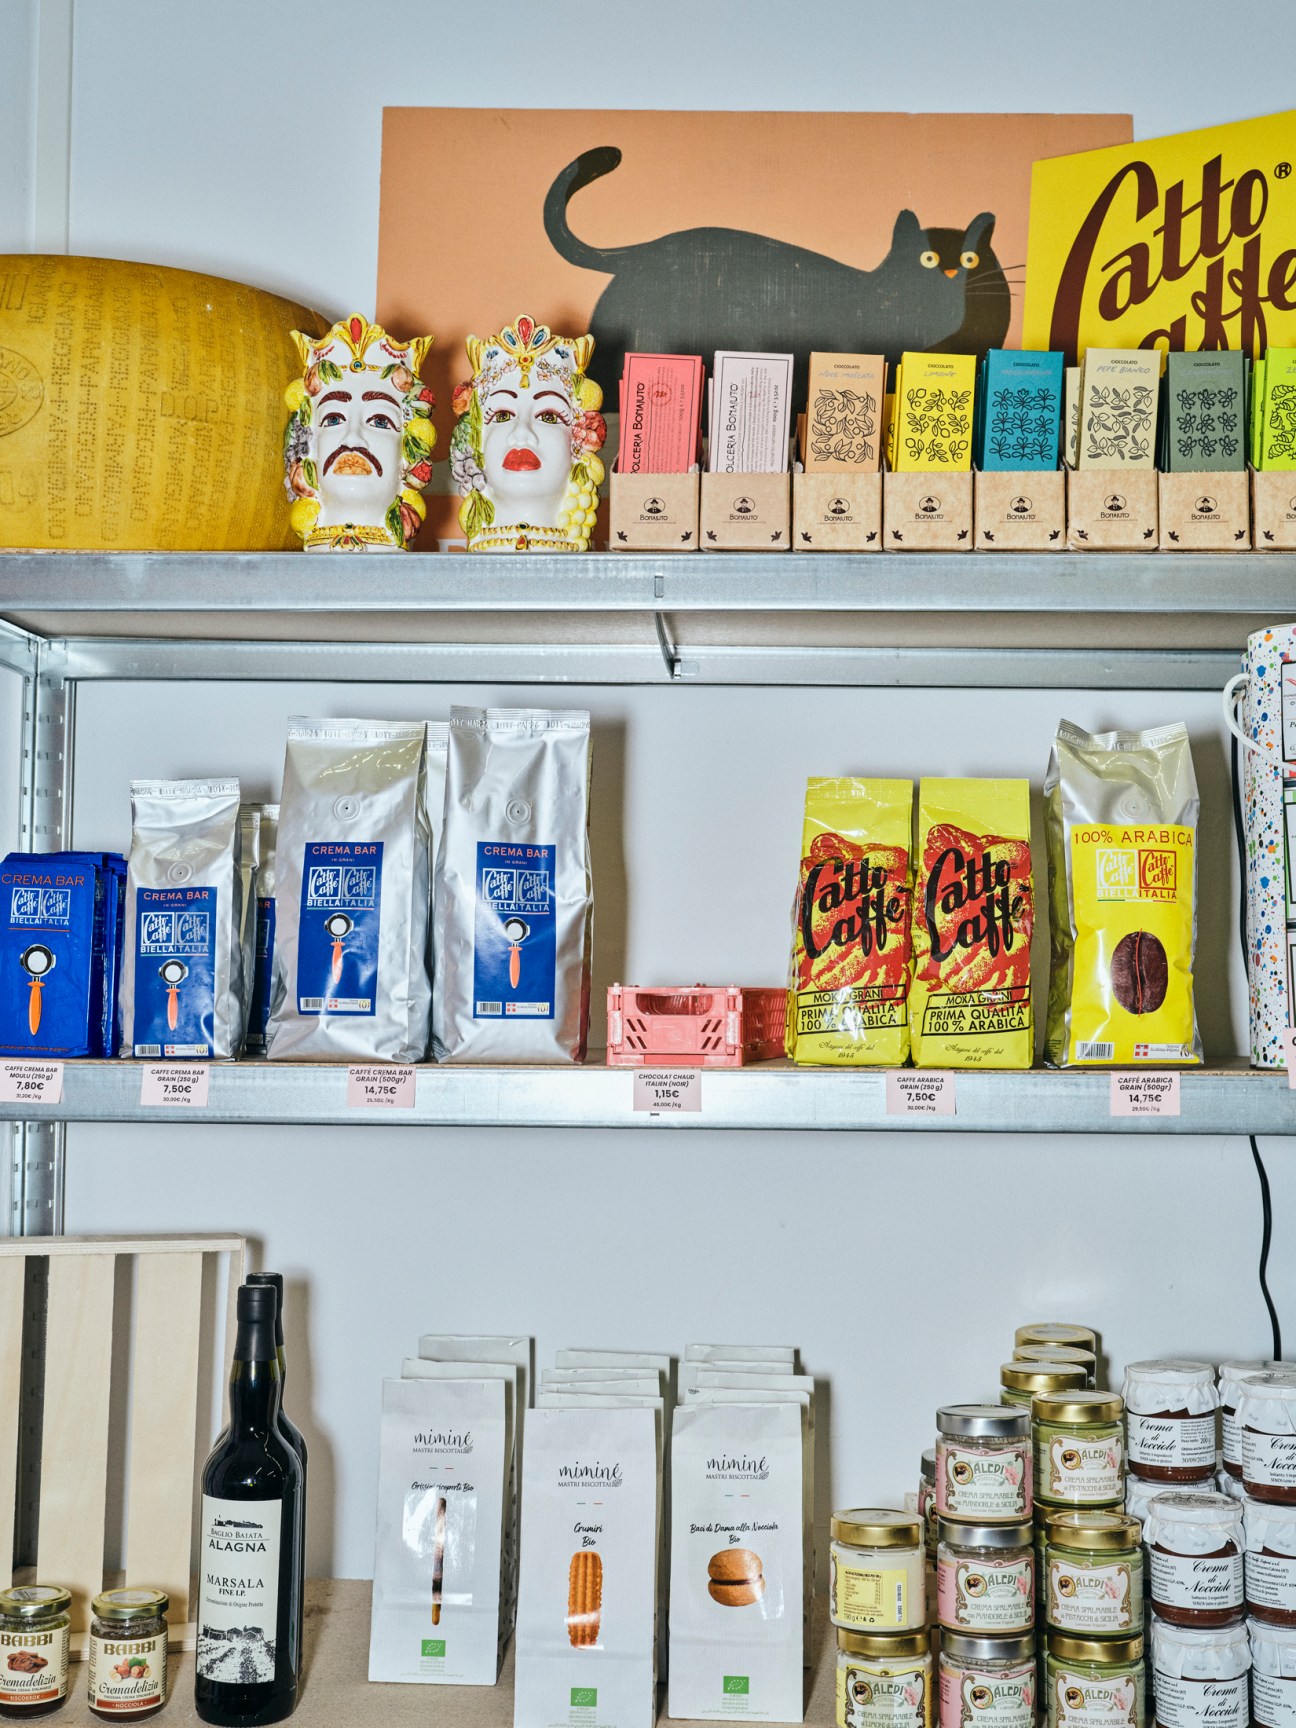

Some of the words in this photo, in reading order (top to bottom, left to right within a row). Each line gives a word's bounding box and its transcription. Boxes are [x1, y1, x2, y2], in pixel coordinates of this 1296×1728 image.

[1097, 365, 1116, 373] PEPE
[1075, 830, 1113, 844] 100%
[1121, 831, 1192, 846] ARABICA
[312, 846, 351, 855] CREMA
[355, 846, 376, 854] BAR
[484, 847, 523, 856] CREMA
[526, 849, 548, 858] BAR
[2, 873, 52, 886] CREMA
[56, 875, 84, 886] BAR
[143, 891, 182, 900] CREMA
[186, 891, 208, 900] BAR
[1096, 889, 1138, 898] BIELLA
[1139, 890, 1177, 899] ITALIA
[41, 917, 69, 926] ITALIA
[140, 945, 174, 953] BIELLA
[849, 989, 883, 1000] GRANI
[946, 995, 974, 1005] MOKA
[977, 992, 1012, 1003] GRANI
[930, 1010, 965, 1021] PRIMA
[801, 1021, 820, 1030] 100
[928, 1021, 950, 1032] 100
[953, 1021, 963, 1031] %
[969, 1018, 1025, 1030] ARABICA
[379, 1076, 406, 1084] (500gr)
[16, 1082, 44, 1090] 7,80€
[163, 1085, 191, 1093] 7,50€
[365, 1086, 396, 1095] 14,75€
[1144, 1083, 1171, 1092] (500gr)
[655, 1090, 679, 1098] 1,15€
[907, 1093, 936, 1102] 7,50€
[1129, 1095, 1162, 1103] 14,75€
[1140, 1418, 1174, 1432] Crema
[414, 1429, 474, 1448] miminé
[1135, 1437, 1176, 1451] Nocciole
[706, 1454, 770, 1473] miminé
[558, 1461, 623, 1480] miminé
[462, 1483, 474, 1492] Bio
[211, 1528, 233, 1538] BAGLIO
[573, 1522, 603, 1533] Crumiri
[690, 1523, 705, 1533] Baci
[706, 1523, 713, 1532] di
[736, 1522, 750, 1531] alla
[582, 1536, 596, 1548] Bio
[728, 1534, 741, 1545] Bio
[209, 1539, 266, 1552] ALAGNA
[1193, 1560, 1229, 1573] Crema
[207, 1573, 264, 1588] MARSALA
[1208, 1574, 1217, 1583] di
[1185, 1579, 1231, 1592] Nocciole
[1, 1633, 53, 1647] BABBI
[104, 1641, 156, 1655] BABBI
[98, 1680, 159, 1695] Cremadelizia
[1203, 1684, 1238, 1697] Crema
[1218, 1698, 1227, 1707] di
[1195, 1702, 1240, 1717] Nocciole
